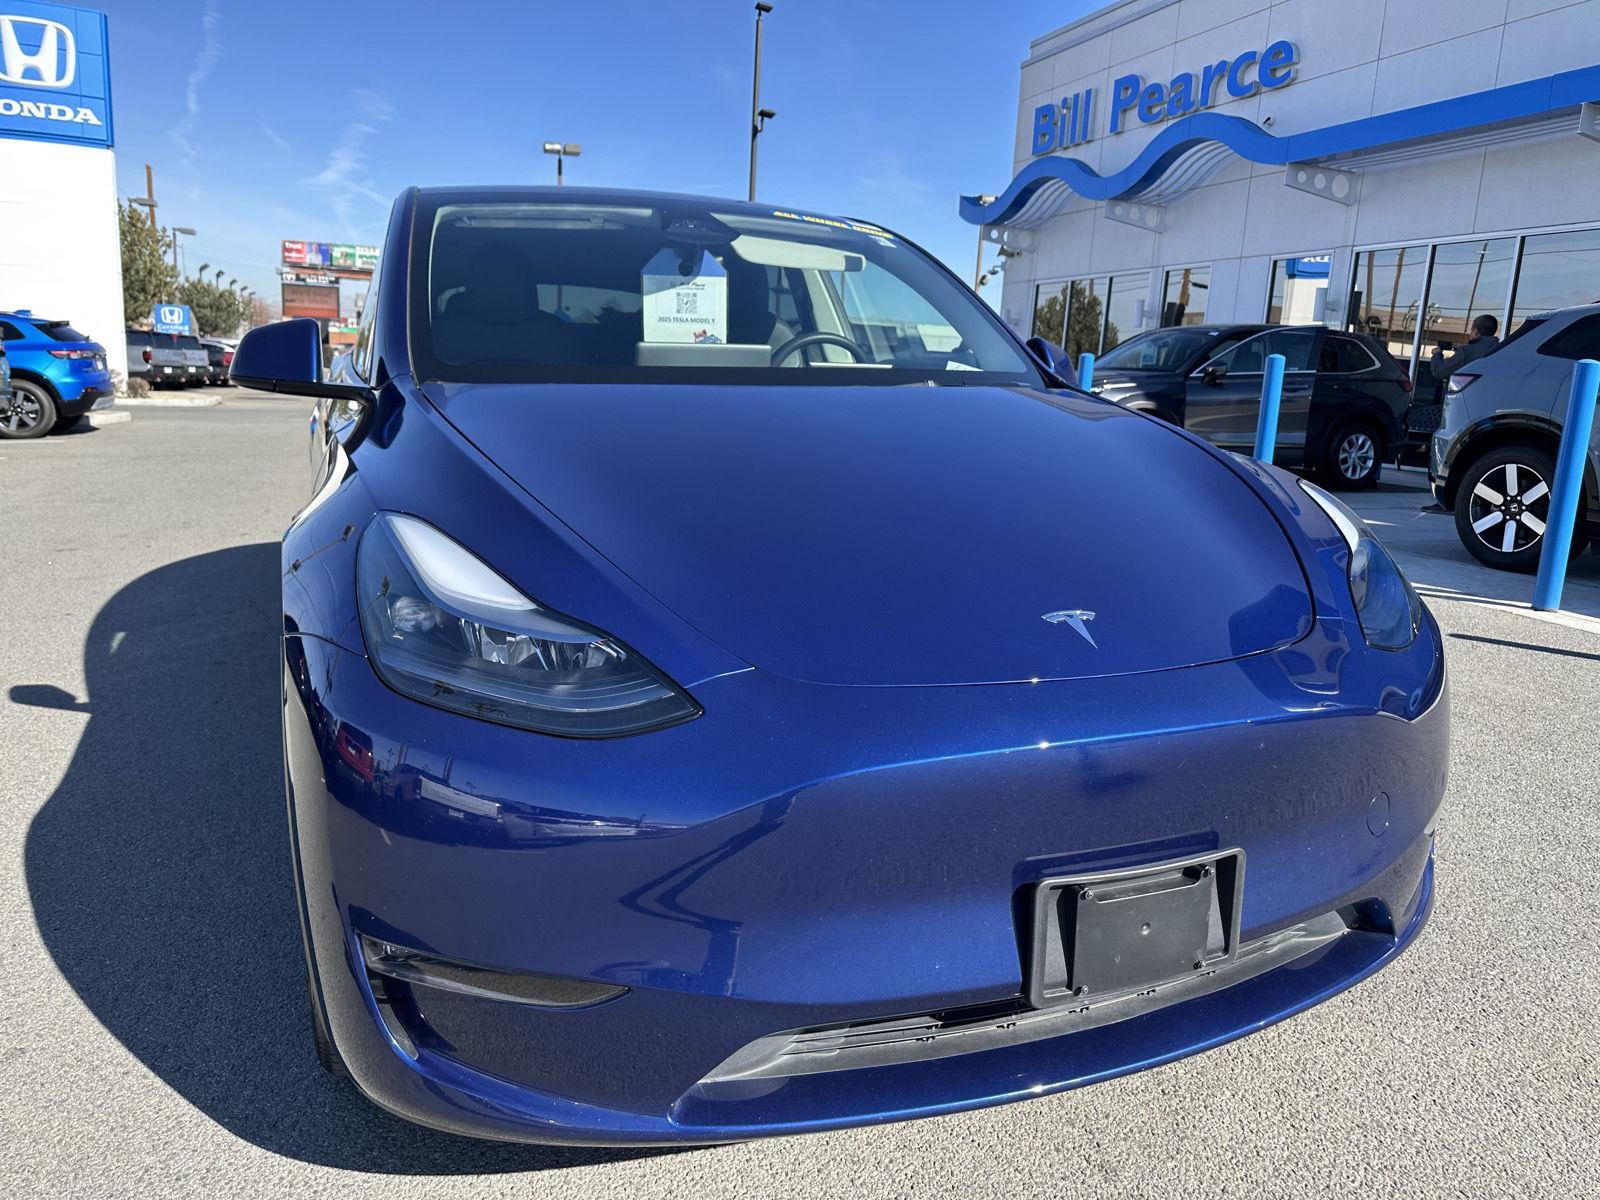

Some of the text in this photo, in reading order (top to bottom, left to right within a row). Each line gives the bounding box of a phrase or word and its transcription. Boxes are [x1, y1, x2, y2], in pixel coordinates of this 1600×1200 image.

[0, 98, 103, 126] ONDA
[1032, 40, 1297, 156] Bill Pearce
